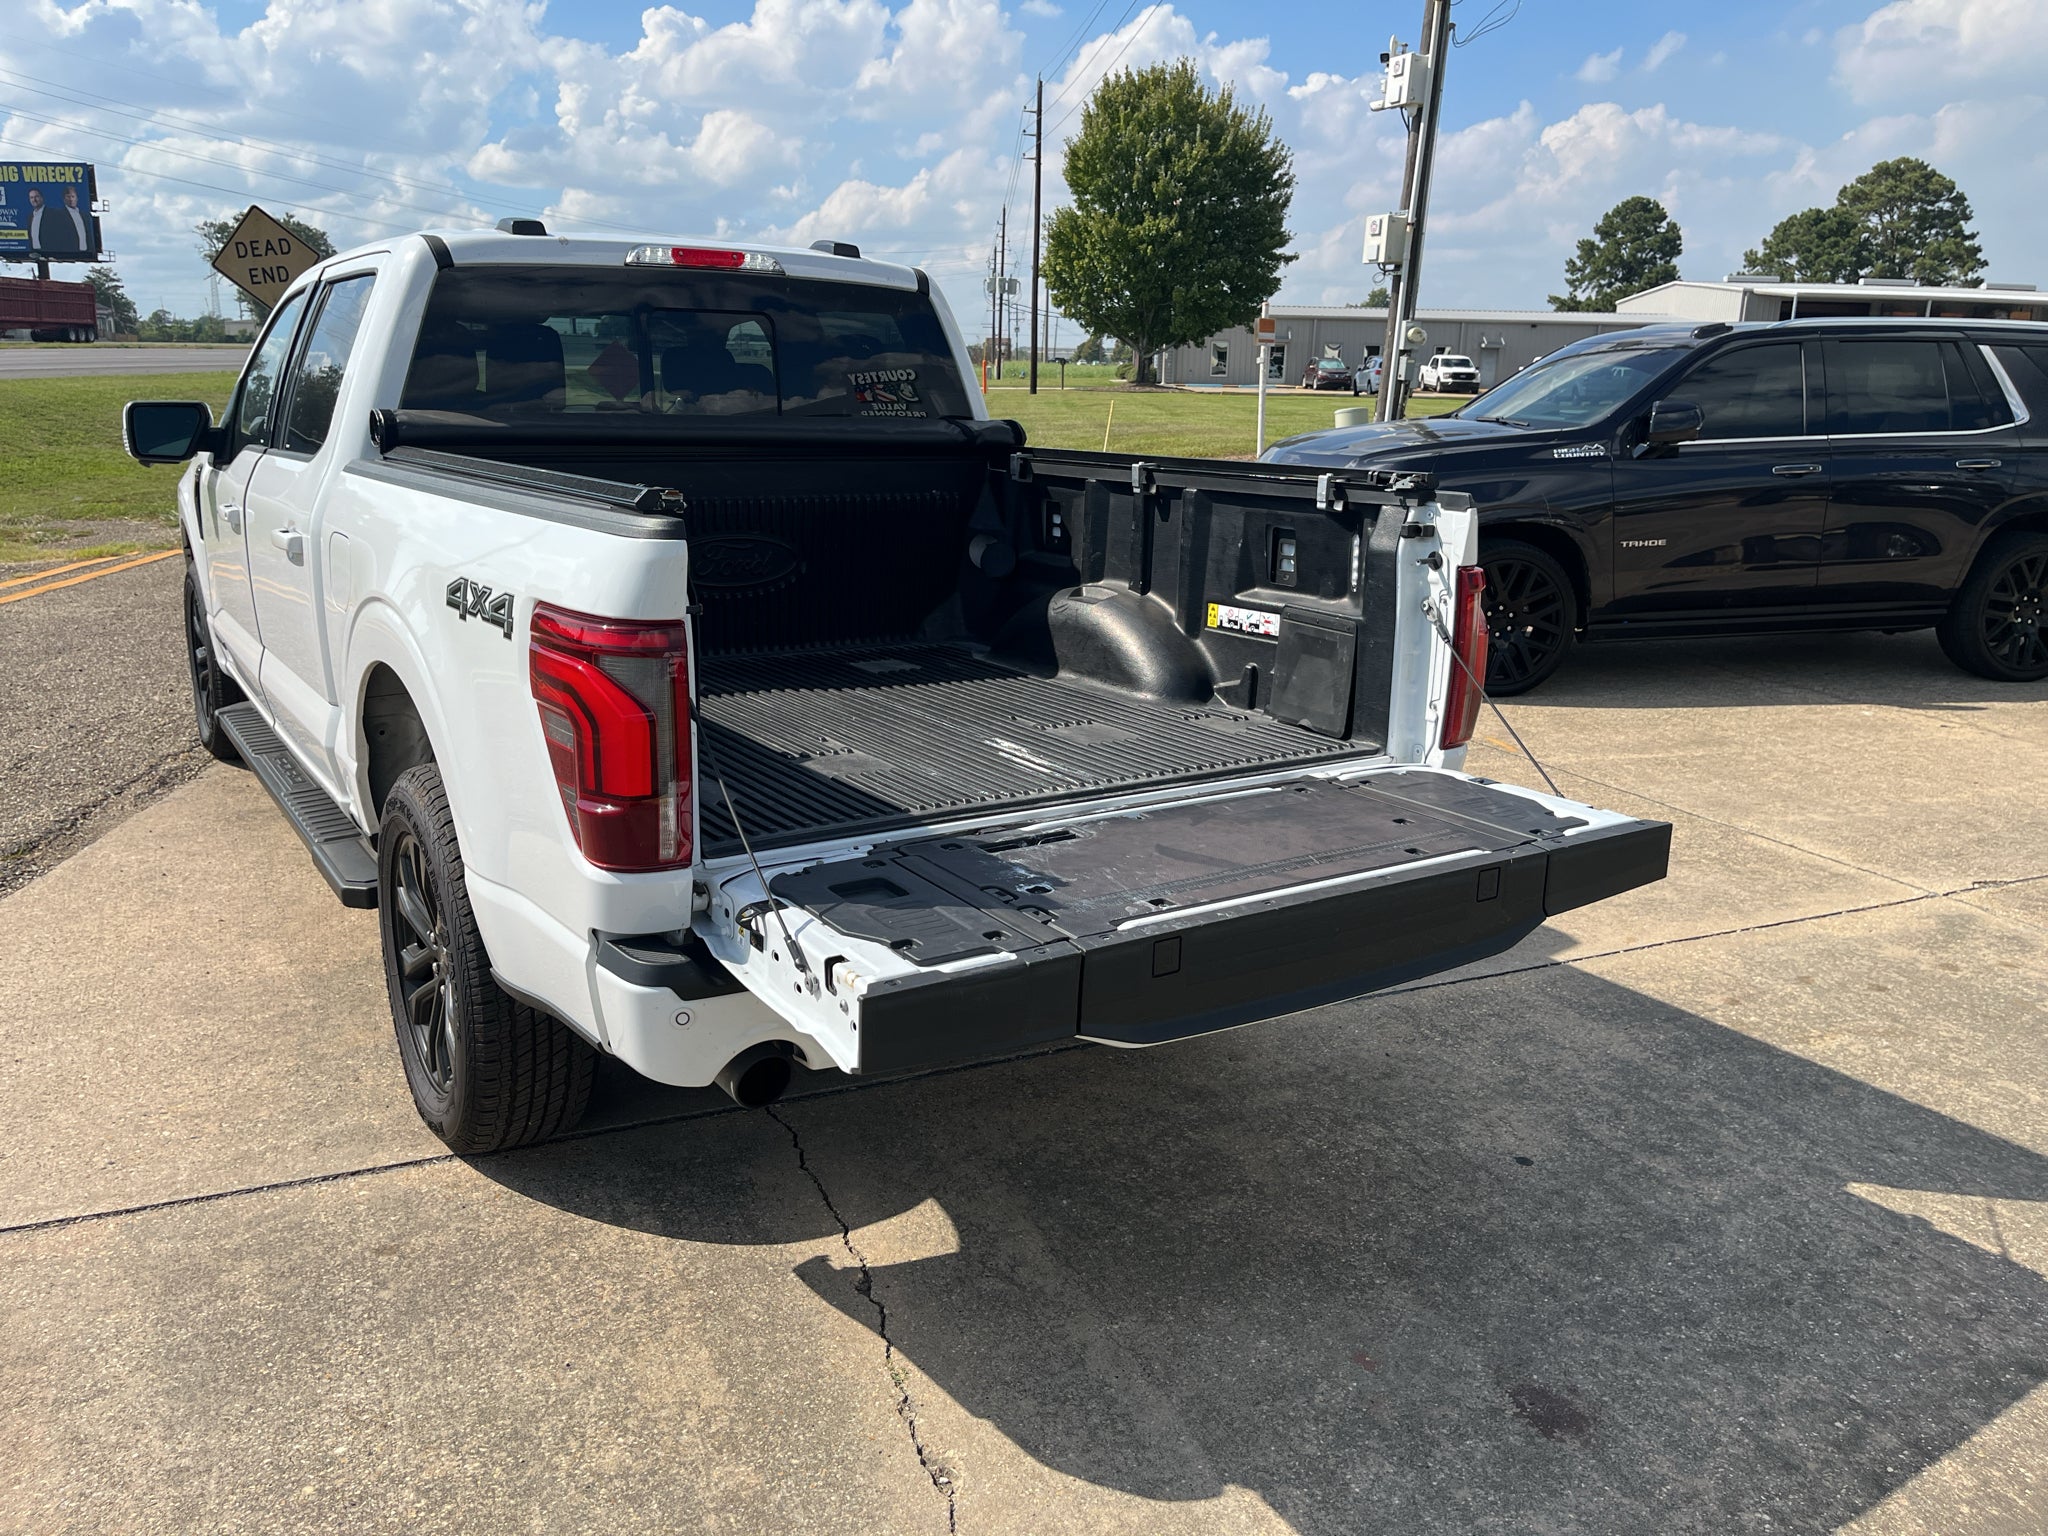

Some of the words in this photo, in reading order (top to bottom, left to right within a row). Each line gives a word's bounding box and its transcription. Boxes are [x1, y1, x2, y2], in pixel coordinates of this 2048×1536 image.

[22, 166, 83, 183] WRECK?
[235, 238, 291, 259] DEAD
[248, 265, 290, 285] END
[1620, 539, 1667, 548] TAHOE
[695, 542, 773, 577] Ford
